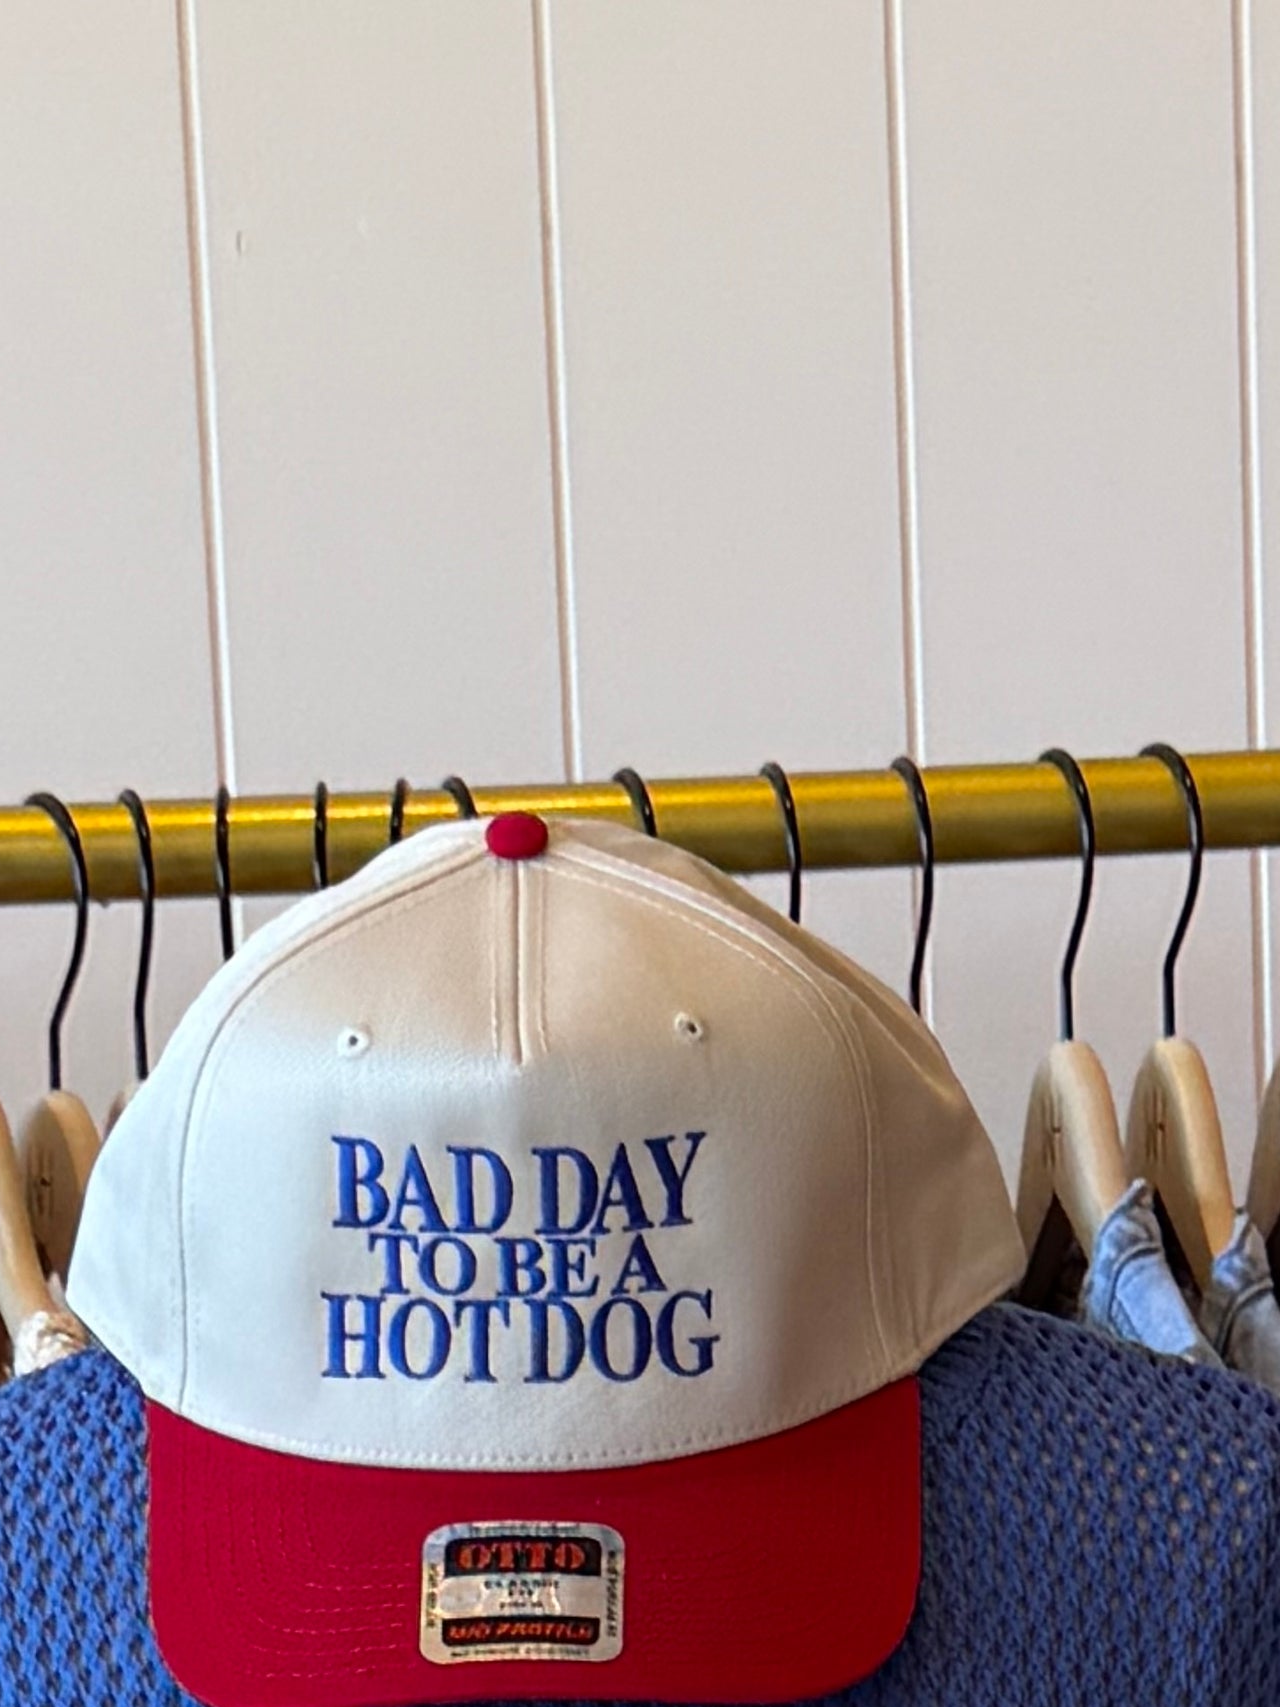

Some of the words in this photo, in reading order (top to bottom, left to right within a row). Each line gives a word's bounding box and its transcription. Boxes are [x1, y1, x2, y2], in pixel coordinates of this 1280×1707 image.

[331, 1136, 514, 1234] BAD
[531, 1131, 707, 1235] DAY
[367, 1233, 478, 1296] TO
[493, 1236, 600, 1298] BE
[611, 1233, 668, 1295] A
[321, 1290, 510, 1384] HOT
[523, 1288, 721, 1384] DOG
[457, 1542, 586, 1570] OTTO
